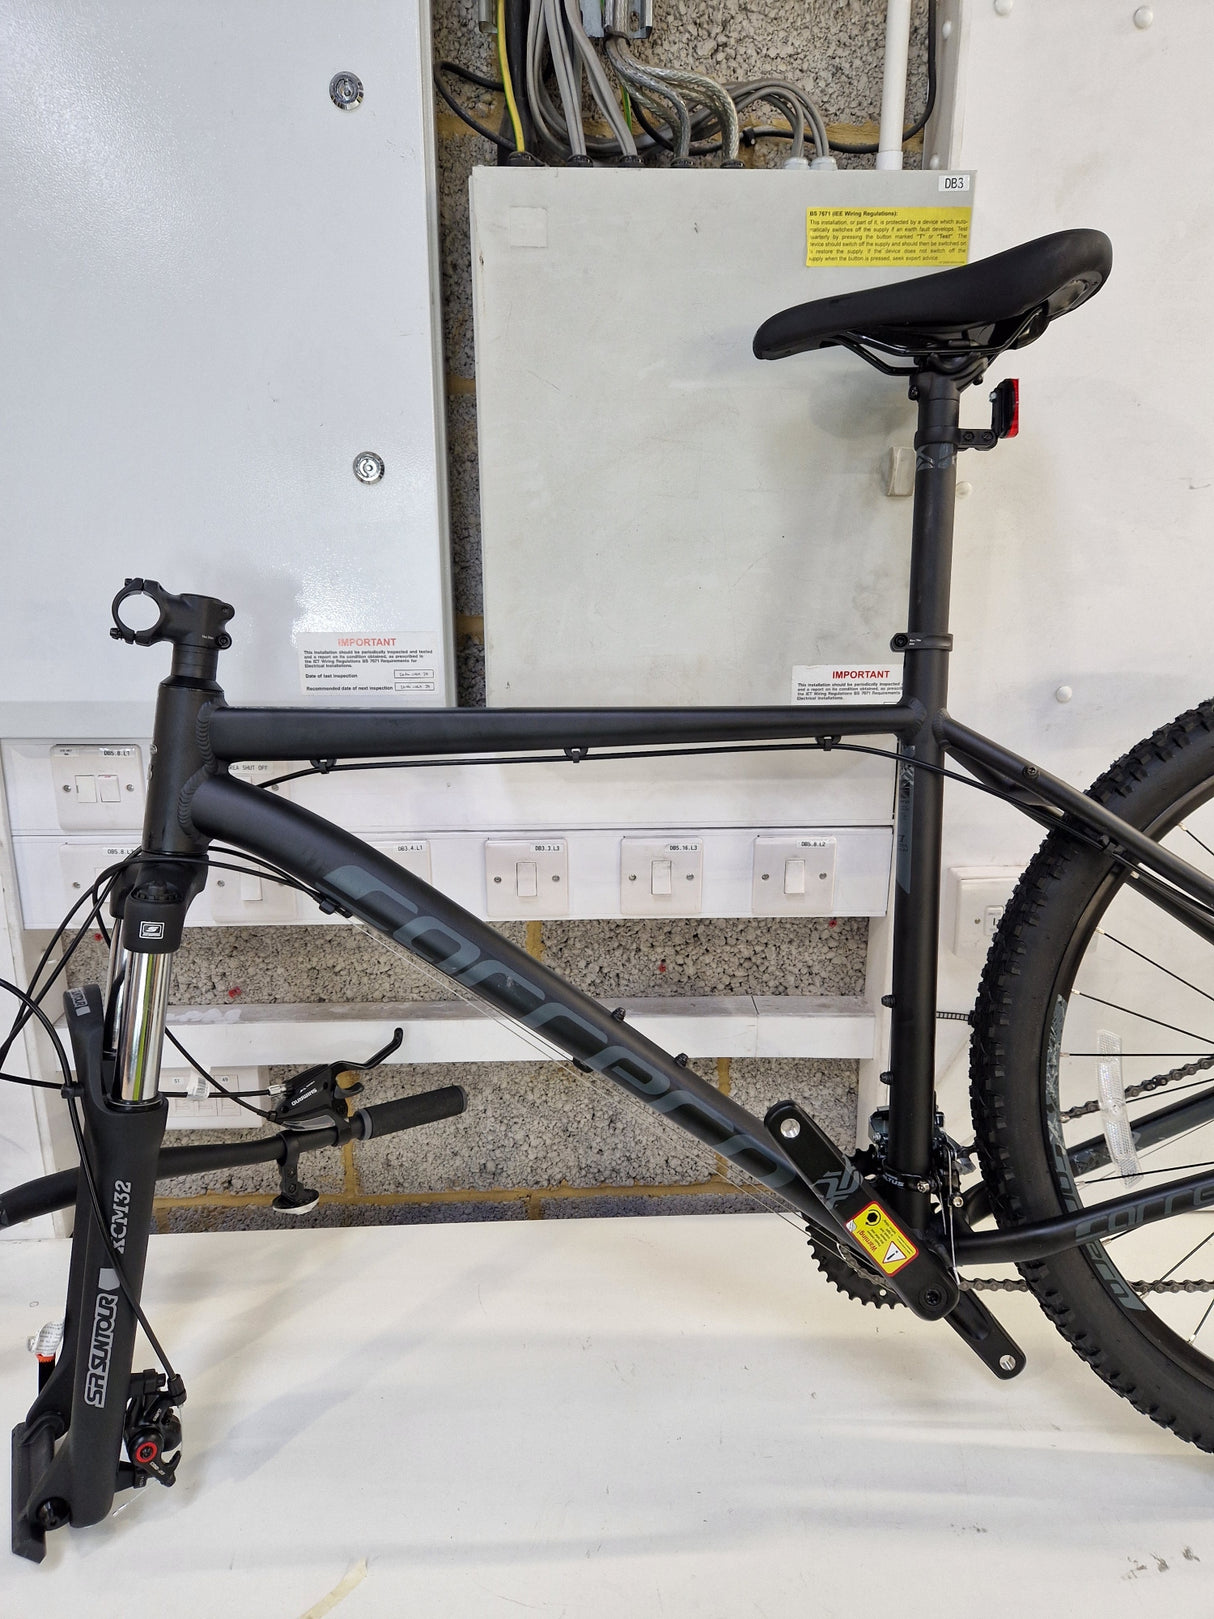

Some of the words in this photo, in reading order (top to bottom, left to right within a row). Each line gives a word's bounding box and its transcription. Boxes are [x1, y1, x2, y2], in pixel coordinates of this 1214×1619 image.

[944, 177, 964, 189] DB3
[338, 638, 397, 647] IMPORTANT
[832, 670, 890, 679] IMPORTANT
[110, 1180, 132, 1254] XCM32
[857, 1229, 878, 1252] Warning!
[88, 1293, 118, 1373] SUNTOUR
[84, 1371, 107, 1408] SR
